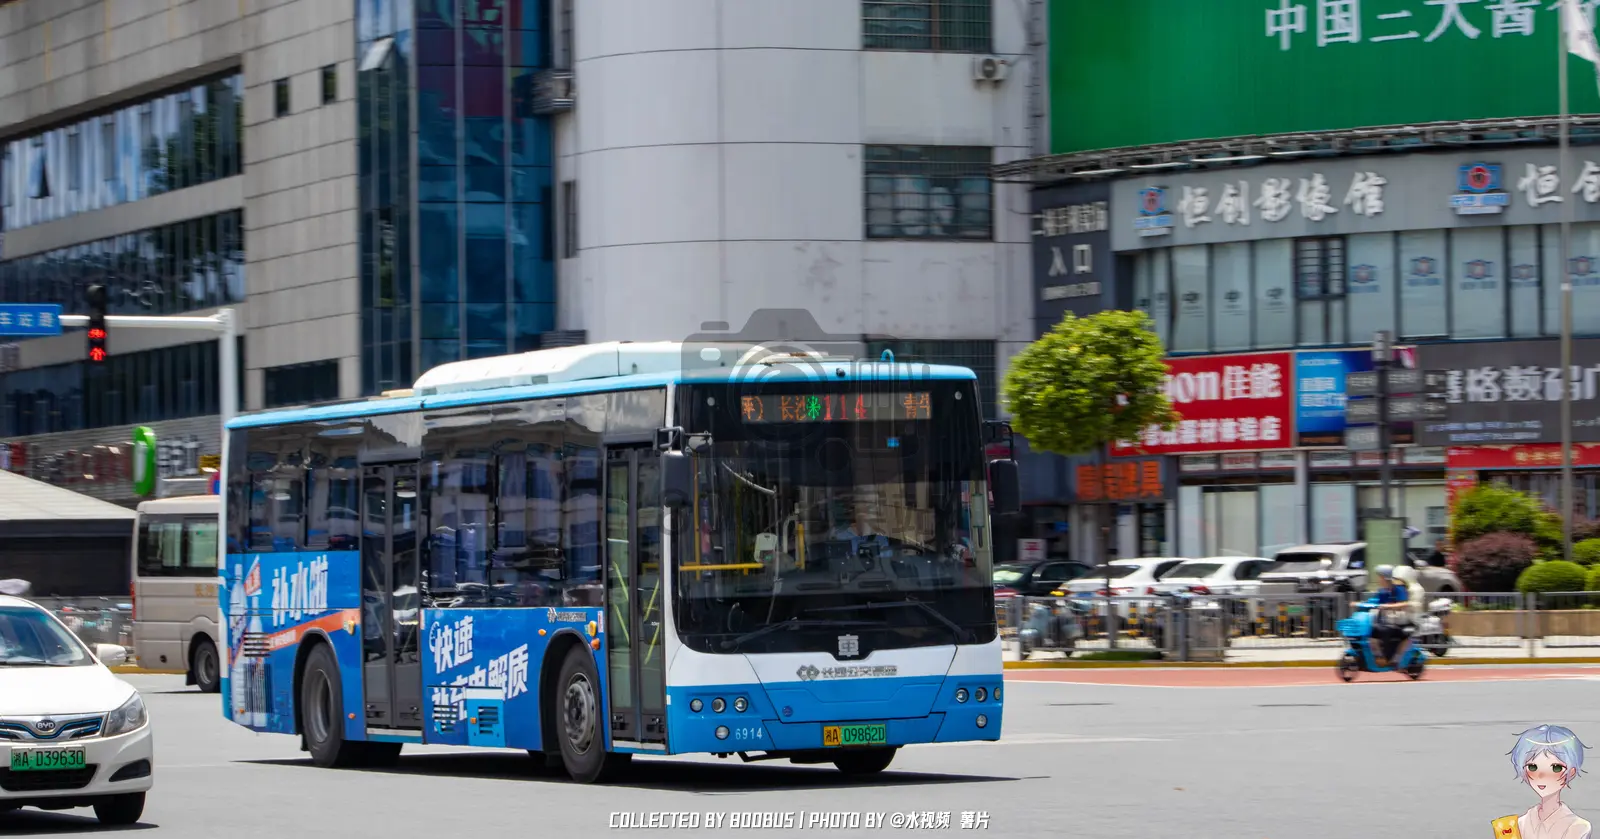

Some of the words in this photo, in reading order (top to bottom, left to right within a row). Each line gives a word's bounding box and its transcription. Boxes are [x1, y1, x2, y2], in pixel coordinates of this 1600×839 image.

[1177, 171, 1388, 228] 恒创影像馆
[1048, 244, 1093, 277] 入口
[1222, 362, 1283, 400] 佳能
[824, 394, 868, 420] 114
[271, 554, 329, 628] 补水啦
[433, 614, 474, 675] 快速
[735, 727, 763, 740] 6914
